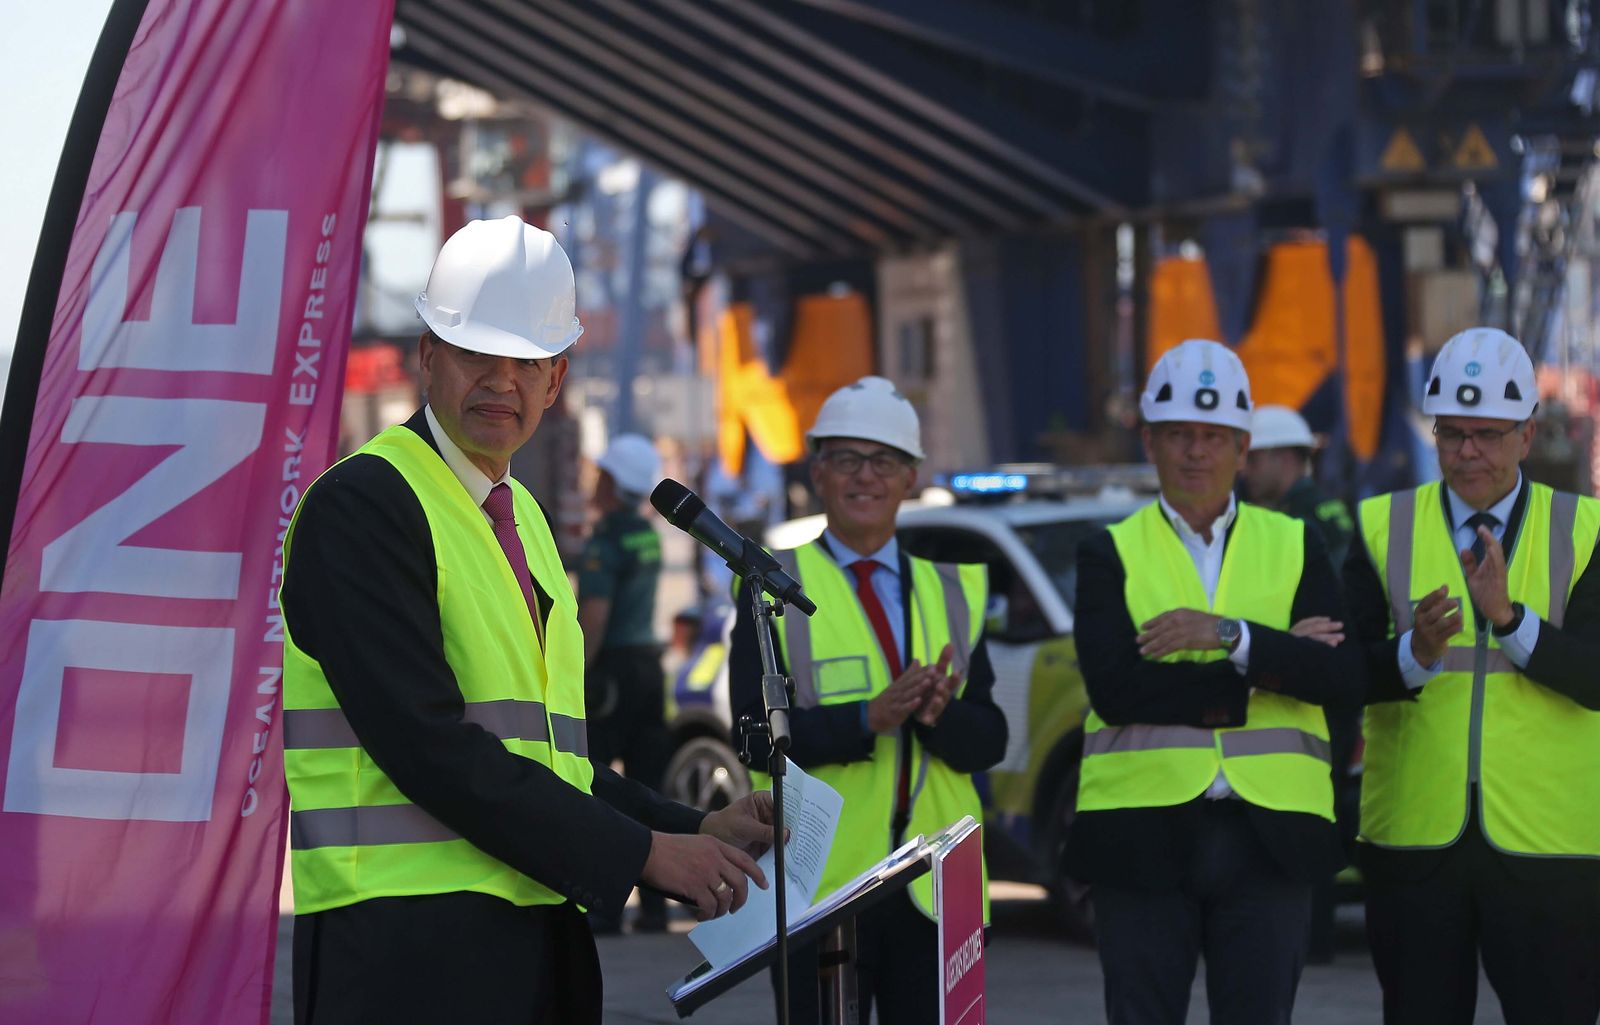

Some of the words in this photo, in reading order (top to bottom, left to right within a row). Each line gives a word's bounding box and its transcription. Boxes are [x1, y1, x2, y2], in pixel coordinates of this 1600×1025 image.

[3, 206, 289, 822] ONE
[241, 667, 283, 817] OCEAN
[288, 213, 336, 406] EXPRESS
